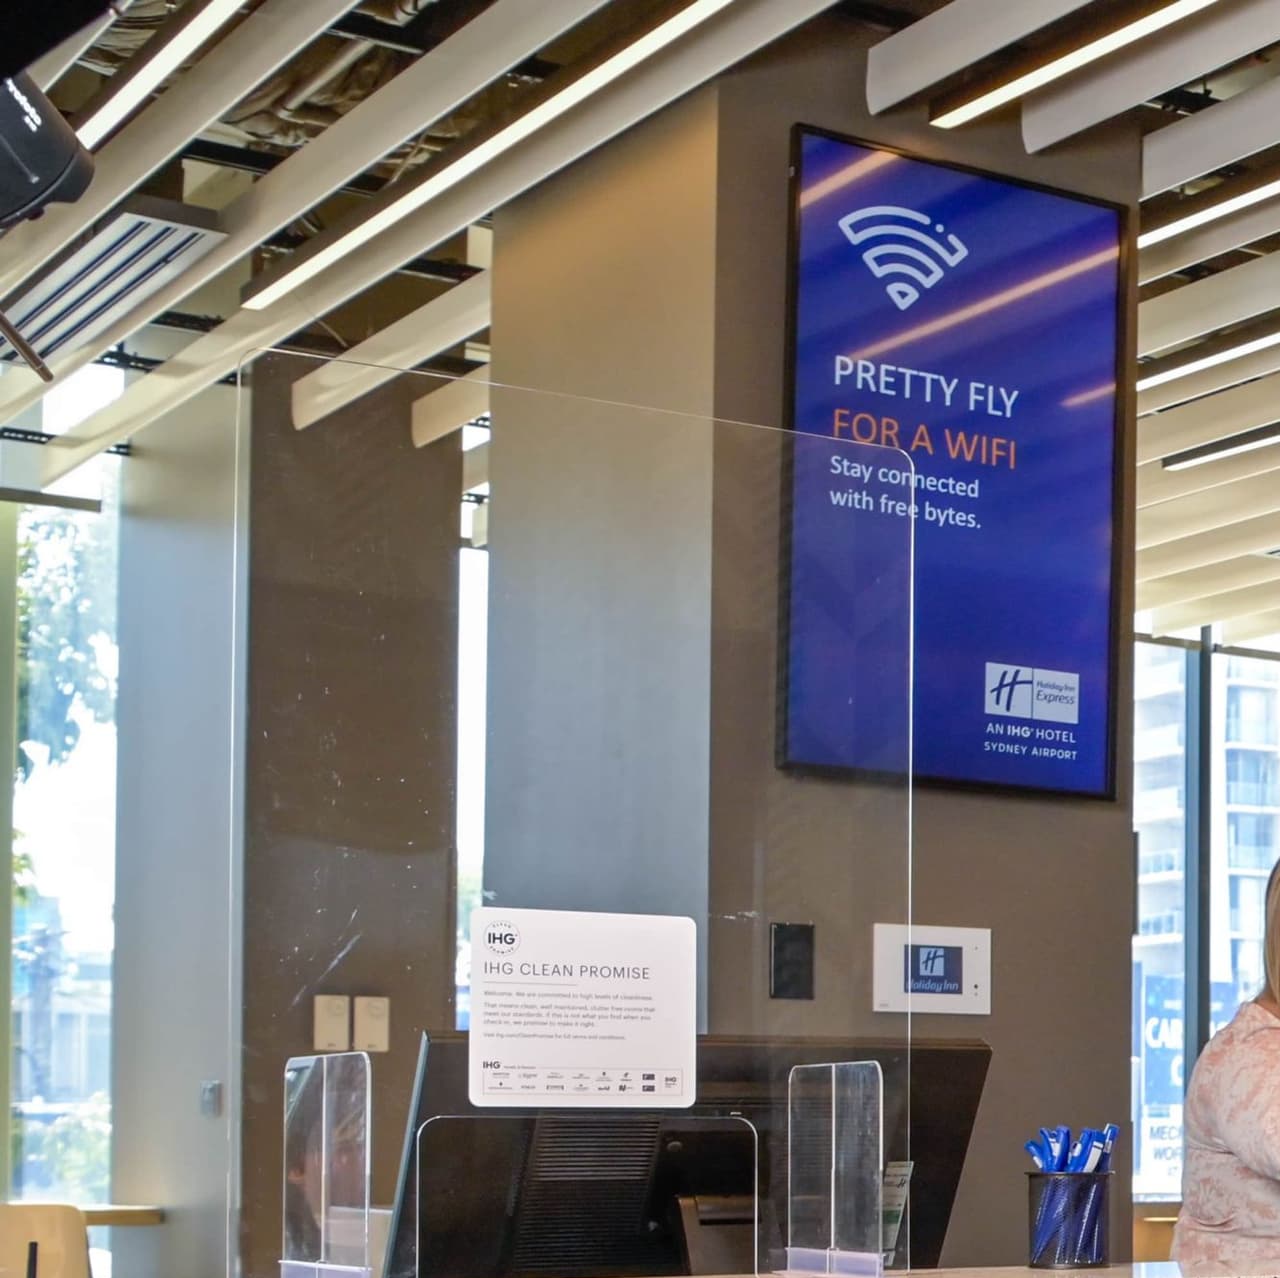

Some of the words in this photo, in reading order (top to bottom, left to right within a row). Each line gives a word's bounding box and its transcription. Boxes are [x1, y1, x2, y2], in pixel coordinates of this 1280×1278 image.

[835, 355, 958, 406] PRETTY
[968, 382, 1019, 418] FLY
[833, 408, 899, 449] FOR
[911, 424, 933, 455] A
[944, 428, 1016, 469] WIFI
[830, 455, 872, 483] Stay
[878, 468, 979, 498] connected
[830, 488, 873, 511] with
[880, 494, 919, 519] free
[925, 501, 981, 528] bytes.
[1036, 690, 1075, 705] Express
[986, 722, 1004, 735] AN
[1035, 728, 1077, 743] HOTEL
[984, 741, 1027, 755] SYDNEY
[1031, 746, 1077, 760] AIRPORT
[487, 933, 516, 945] IHG
[484, 961, 513, 975] IHG
[519, 962, 574, 977] CLEAN
[579, 965, 651, 980] PROMISE
[482, 1061, 500, 1069] IHG
